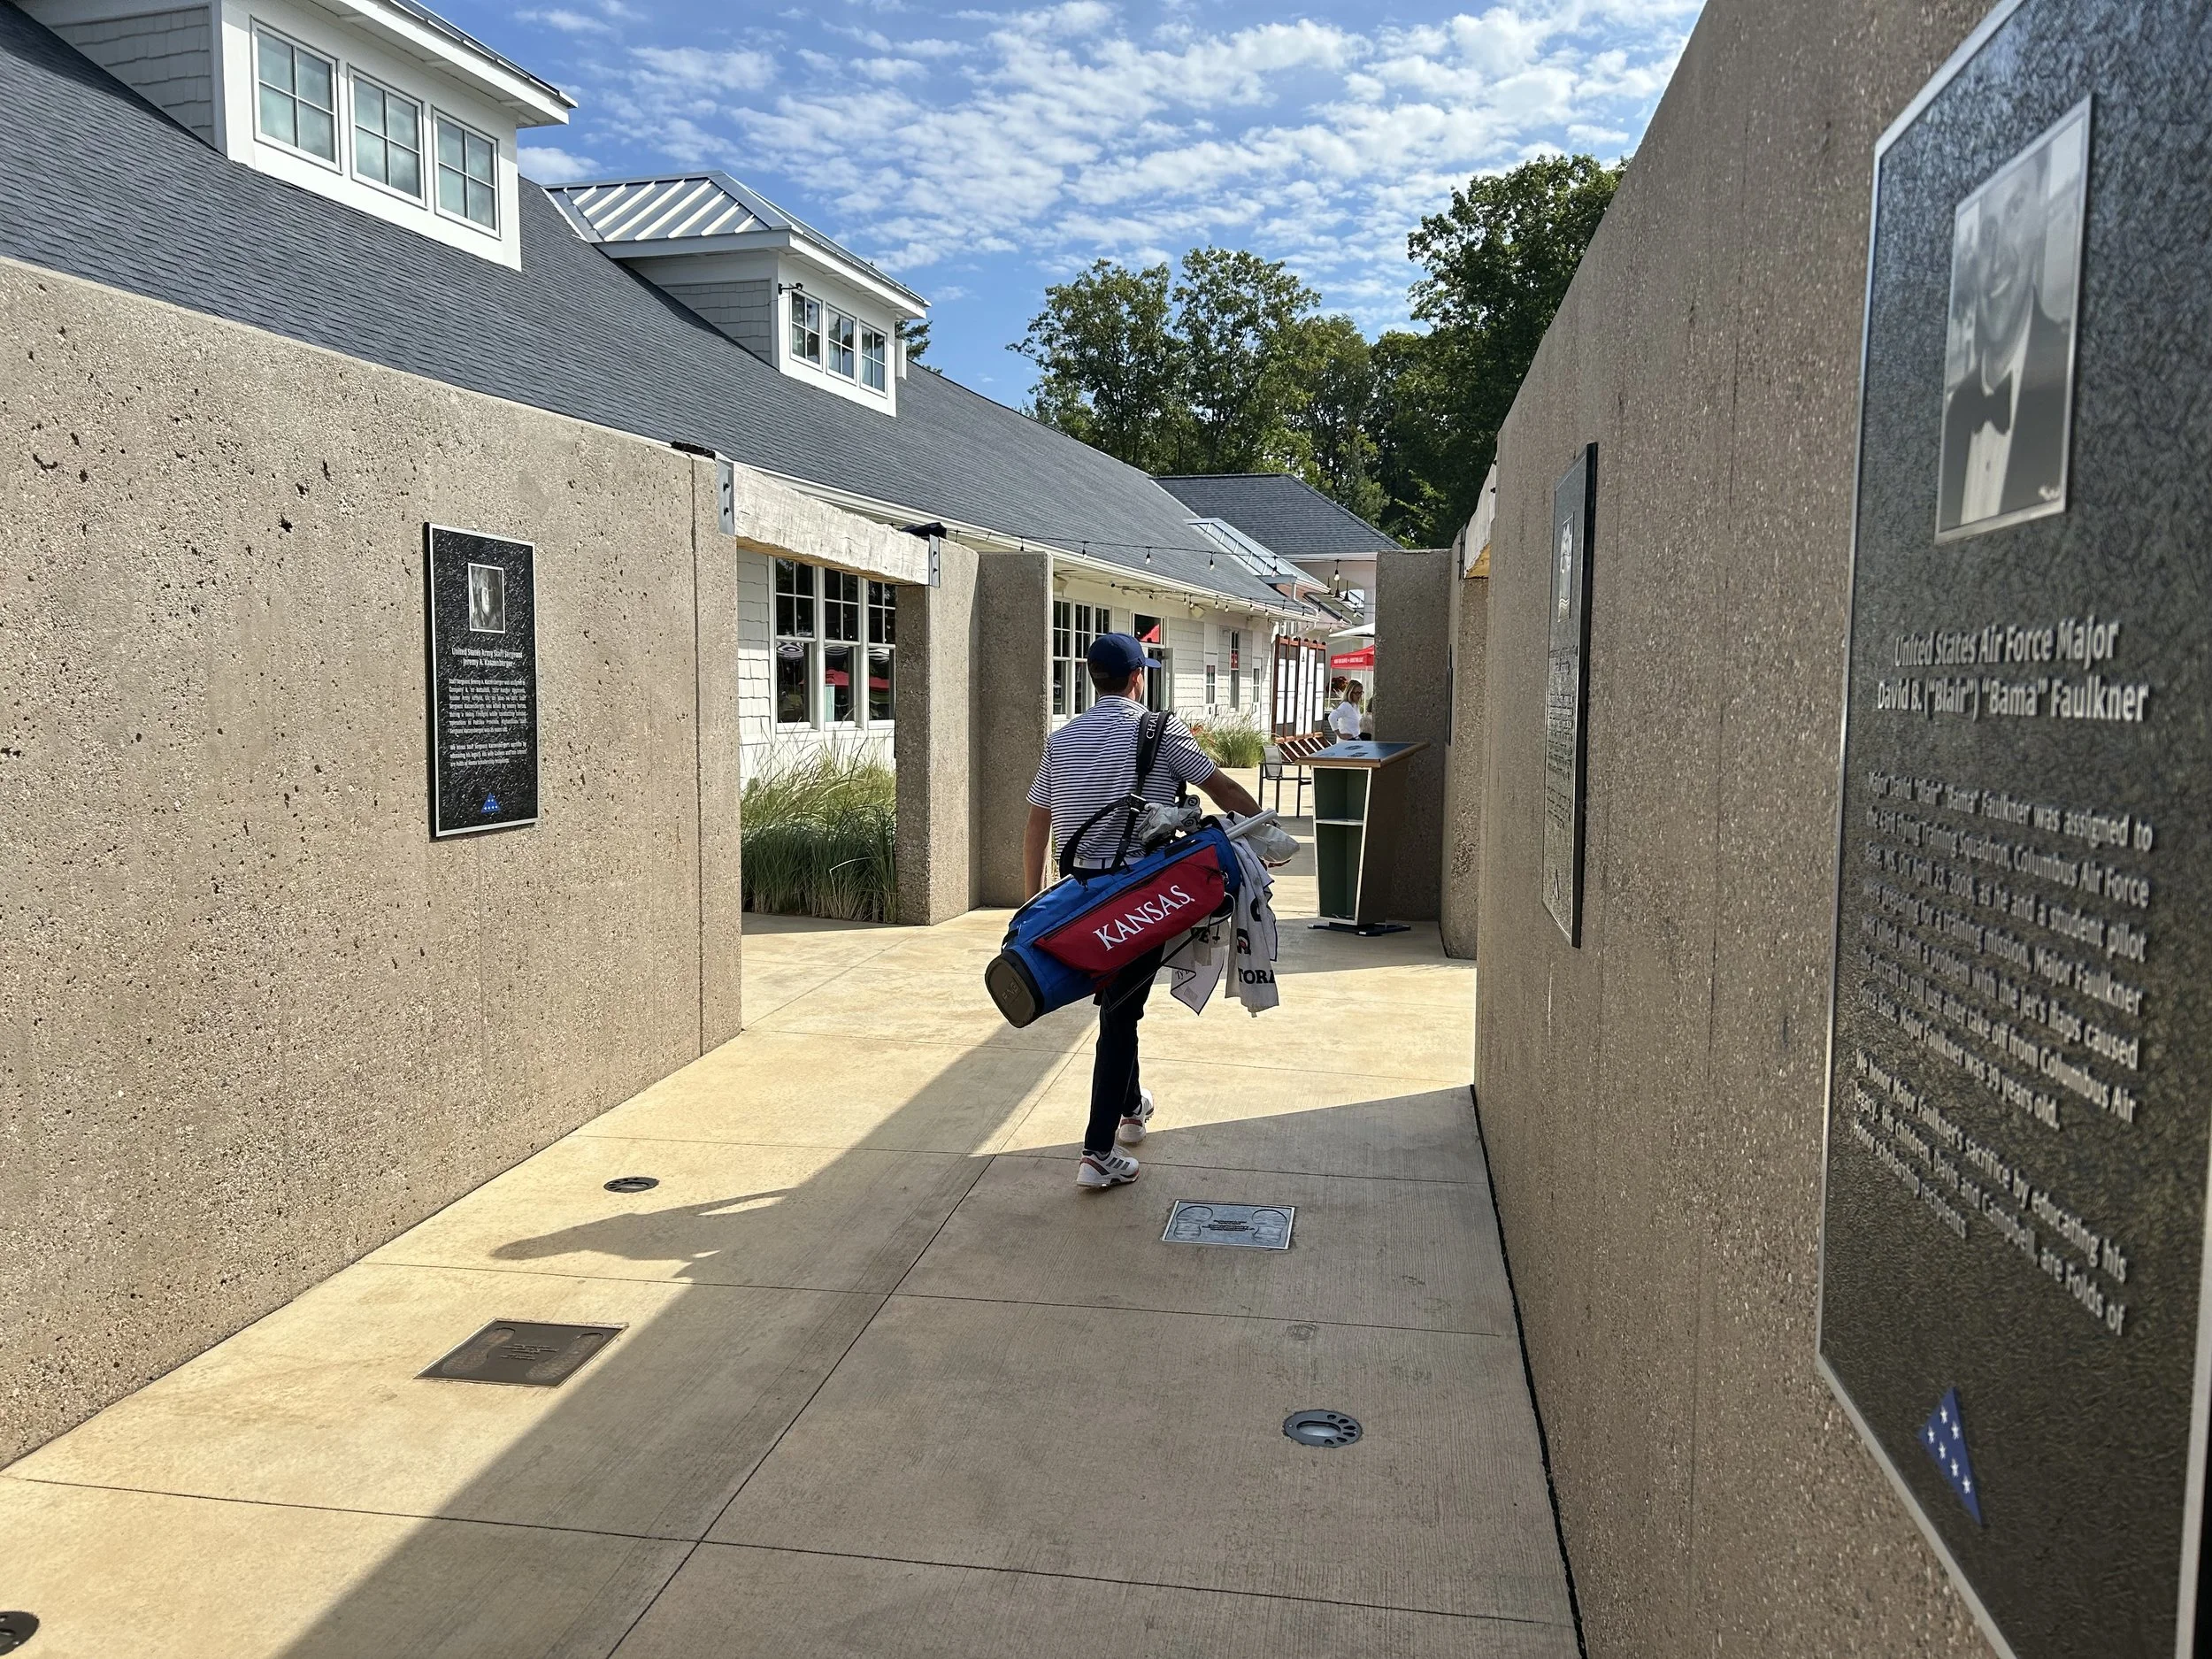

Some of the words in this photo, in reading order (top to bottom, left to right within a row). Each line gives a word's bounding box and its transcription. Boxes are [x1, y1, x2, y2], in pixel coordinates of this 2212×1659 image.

[451, 647, 466, 657] United
[467, 648, 480, 657] States
[481, 648, 494, 657] Army
[504, 649, 523, 659] Sergeant
[463, 658, 479, 667] Jeremy
[1894, 633, 1935, 666] United
[1935, 629, 1976, 664] States
[1978, 626, 2002, 663] Air
[2005, 625, 2053, 662] Force
[2056, 616, 2120, 670] Major
[1878, 679, 1908, 710] David
[1910, 681, 1923, 710] B.
[2050, 676, 2149, 722] Faulkner
[1981, 789, 2032, 826] Faulkner
[2033, 804, 2060, 833] was
[2062, 810, 2129, 850] assigned
[2133, 817, 2153, 853] to
[1919, 820, 1957, 858] Training
[1958, 830, 2012, 872] Squadron,
[2013, 845, 2078, 886] Columbus
[2078, 859, 2102, 896] Air
[2103, 864, 2150, 910] Force
[1093, 885, 1192, 951] KANSAS
[1921, 897, 1933, 920] for
[1934, 910, 1941, 932] a
[1943, 910, 1983, 955] training
[1984, 927, 2032, 972] mission,
[2033, 944, 2072, 993] Major
[2074, 960, 2141, 1017] Faulkner
[1978, 882, 1991, 907] as
[1993, 879, 2009, 914] he
[2010, 887, 2035, 923] and
[2037, 902, 2046, 926] a
[2048, 906, 2104, 948] student
[2106, 922, 2147, 964] pilot
[1900, 968, 1909, 993] to
[1909, 972, 1924, 1004] roll
[1925, 980, 1942, 1016] just
[1943, 990, 1966, 1027] after
[1967, 1004, 1991, 1041] take
[1991, 1020, 2008, 1048] off
[2008, 1026, 2039, 1067] from
[2039, 1047, 2109, 1108] Columbus
[2109, 1080, 2136, 1125] Air
[1923, 942, 1928, 964] a
[1930, 945, 1970, 987] problem
[1970, 963, 1996, 999] with
[1998, 976, 2018, 1010] the
[2019, 986, 2047, 1025] jet's
[2047, 1001, 2082, 1045] flaps
[2083, 1023, 2139, 1070] caused
[1899, 1004, 1923, 1044] Major
[1924, 1018, 1963, 1067] Faulkner
[1964, 1050, 1985, 1082] was
[1985, 1061, 2000, 1094] 39
[2001, 1076, 2033, 1113] years
[2033, 1092, 2061, 1131] old.
[1853, 1114, 1875, 1154] Honor
[1874, 1141, 1920, 1198] scholarship
[1855, 1047, 1867, 1075] We
[1868, 1056, 1891, 1094] honor
[1893, 1075, 1916, 1118] Major
[1917, 1095, 1963, 1149] Faulkner's
[1964, 1138, 2010, 1188] sacrifice
[2012, 1170, 2030, 1210] by
[2030, 1191, 2100, 1267] educating
[2101, 1239, 2127, 1284] his
[1881, 1103, 1894, 1134] His
[1894, 1119, 1932, 1167] children,
[1933, 1147, 1959, 1191] Davis
[1960, 1173, 1980, 1211] and
[2039, 1248, 2063, 1283] are
[2064, 1263, 2104, 1318] Folds
[2106, 1303, 2125, 1336] of
